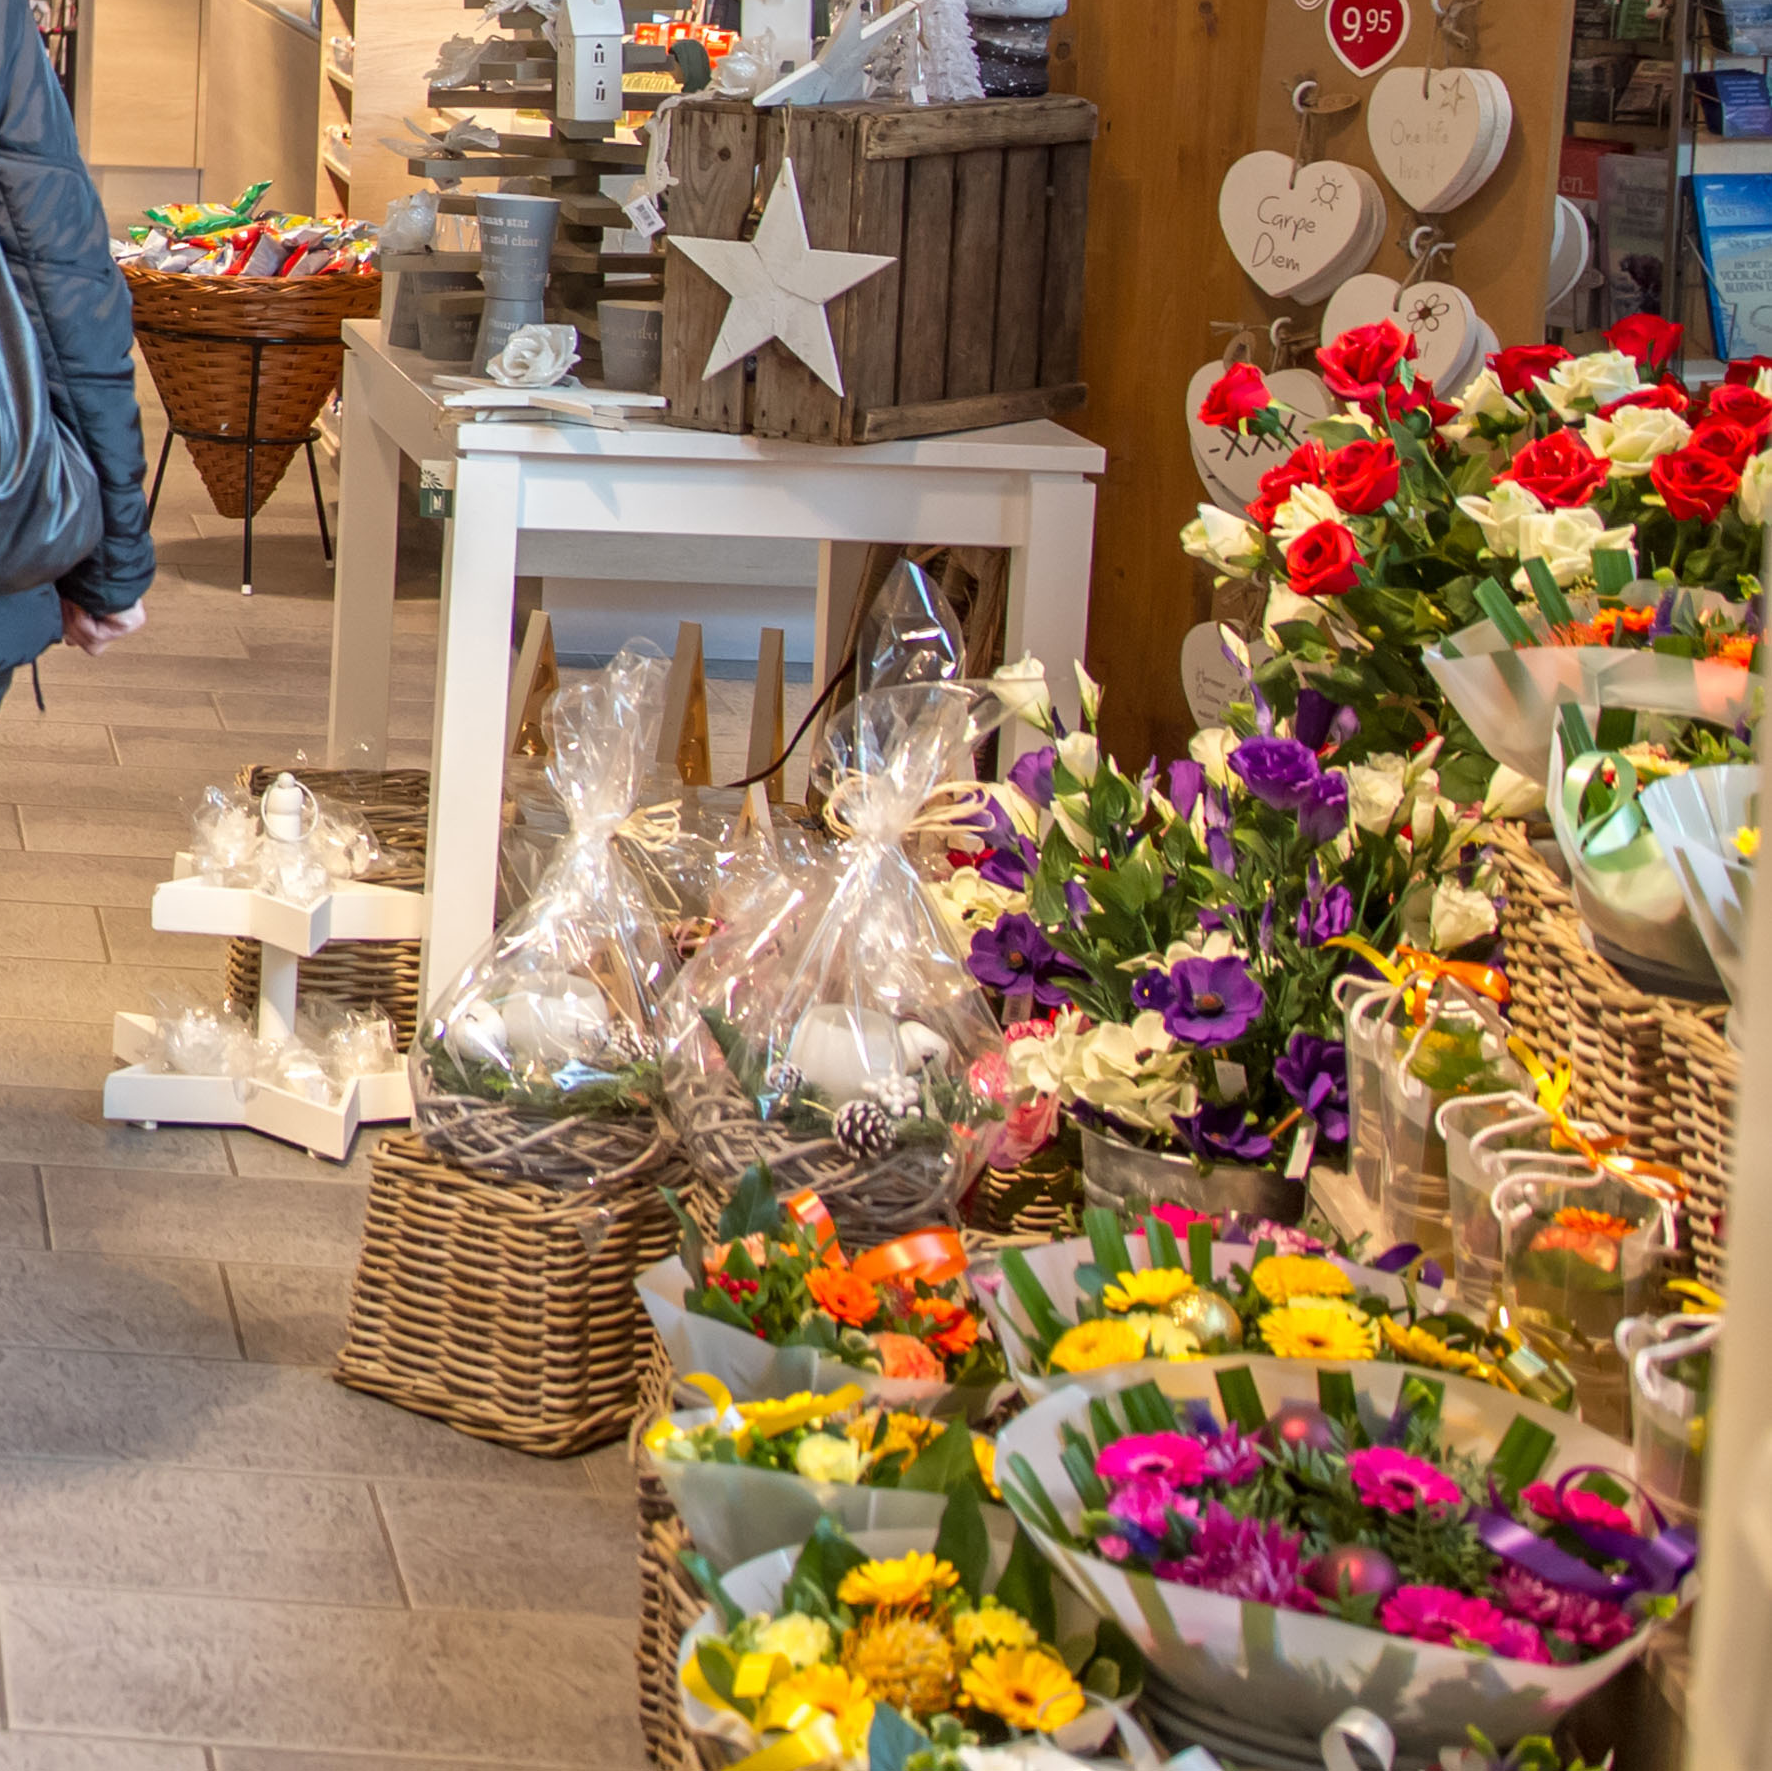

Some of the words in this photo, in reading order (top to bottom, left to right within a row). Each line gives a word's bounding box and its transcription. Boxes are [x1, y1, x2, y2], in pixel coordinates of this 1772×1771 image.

[1342, 6, 1392, 42] 9,95
[1257, 195, 1317, 242] Carpe
[1251, 231, 1301, 273] Diem
